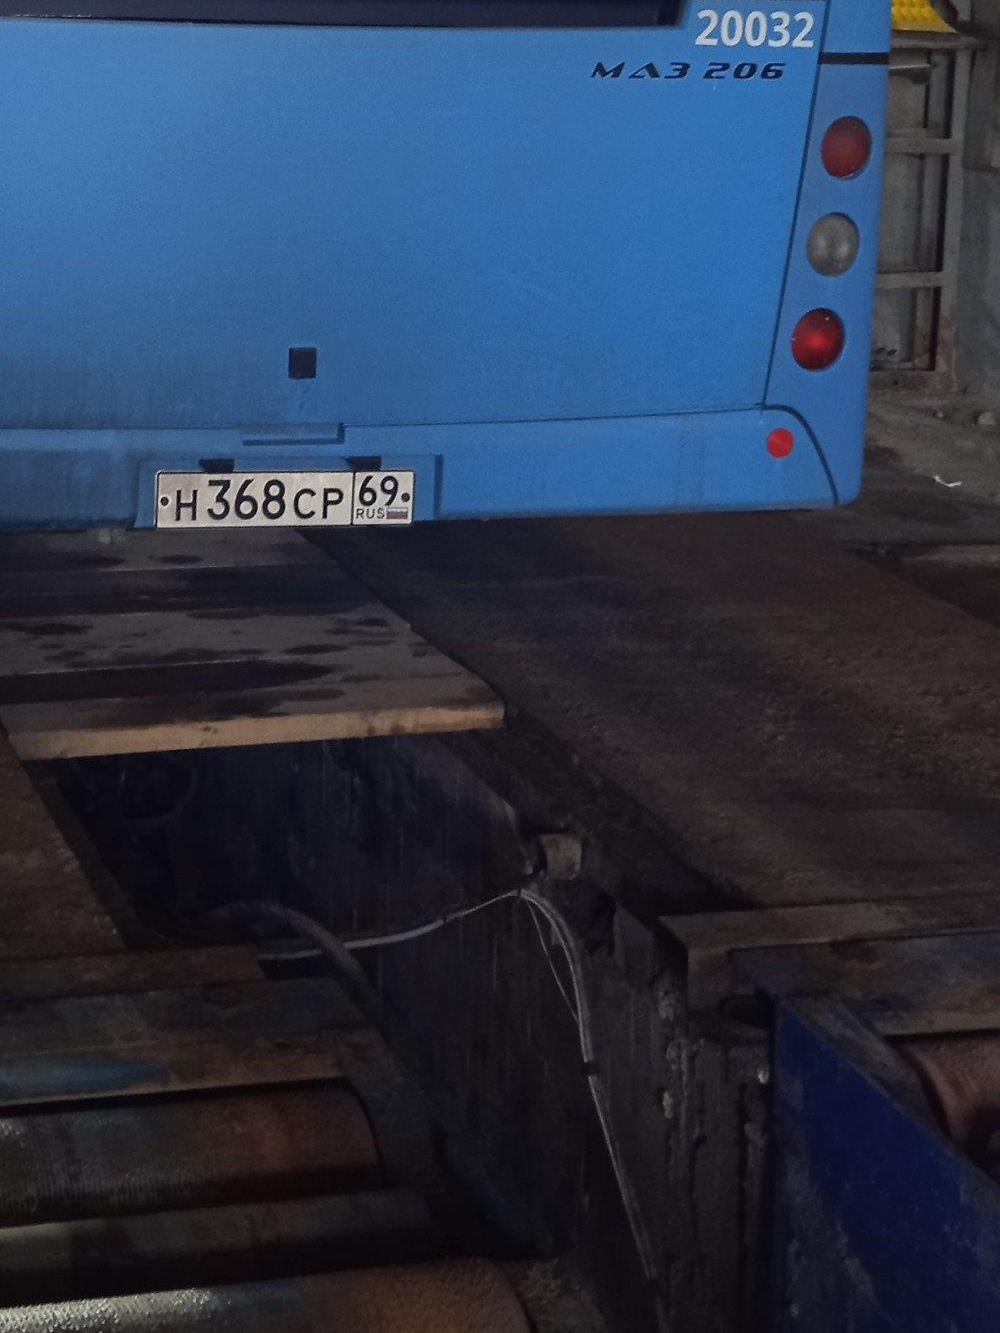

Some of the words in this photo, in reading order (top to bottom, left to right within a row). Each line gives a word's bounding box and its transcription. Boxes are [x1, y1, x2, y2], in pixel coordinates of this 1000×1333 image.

[694, 9, 815, 48] 20032
[590, 61, 691, 79] МАЗ
[702, 62, 786, 79] 206
[358, 475, 400, 507] 69
[356, 507, 385, 520] RUS
